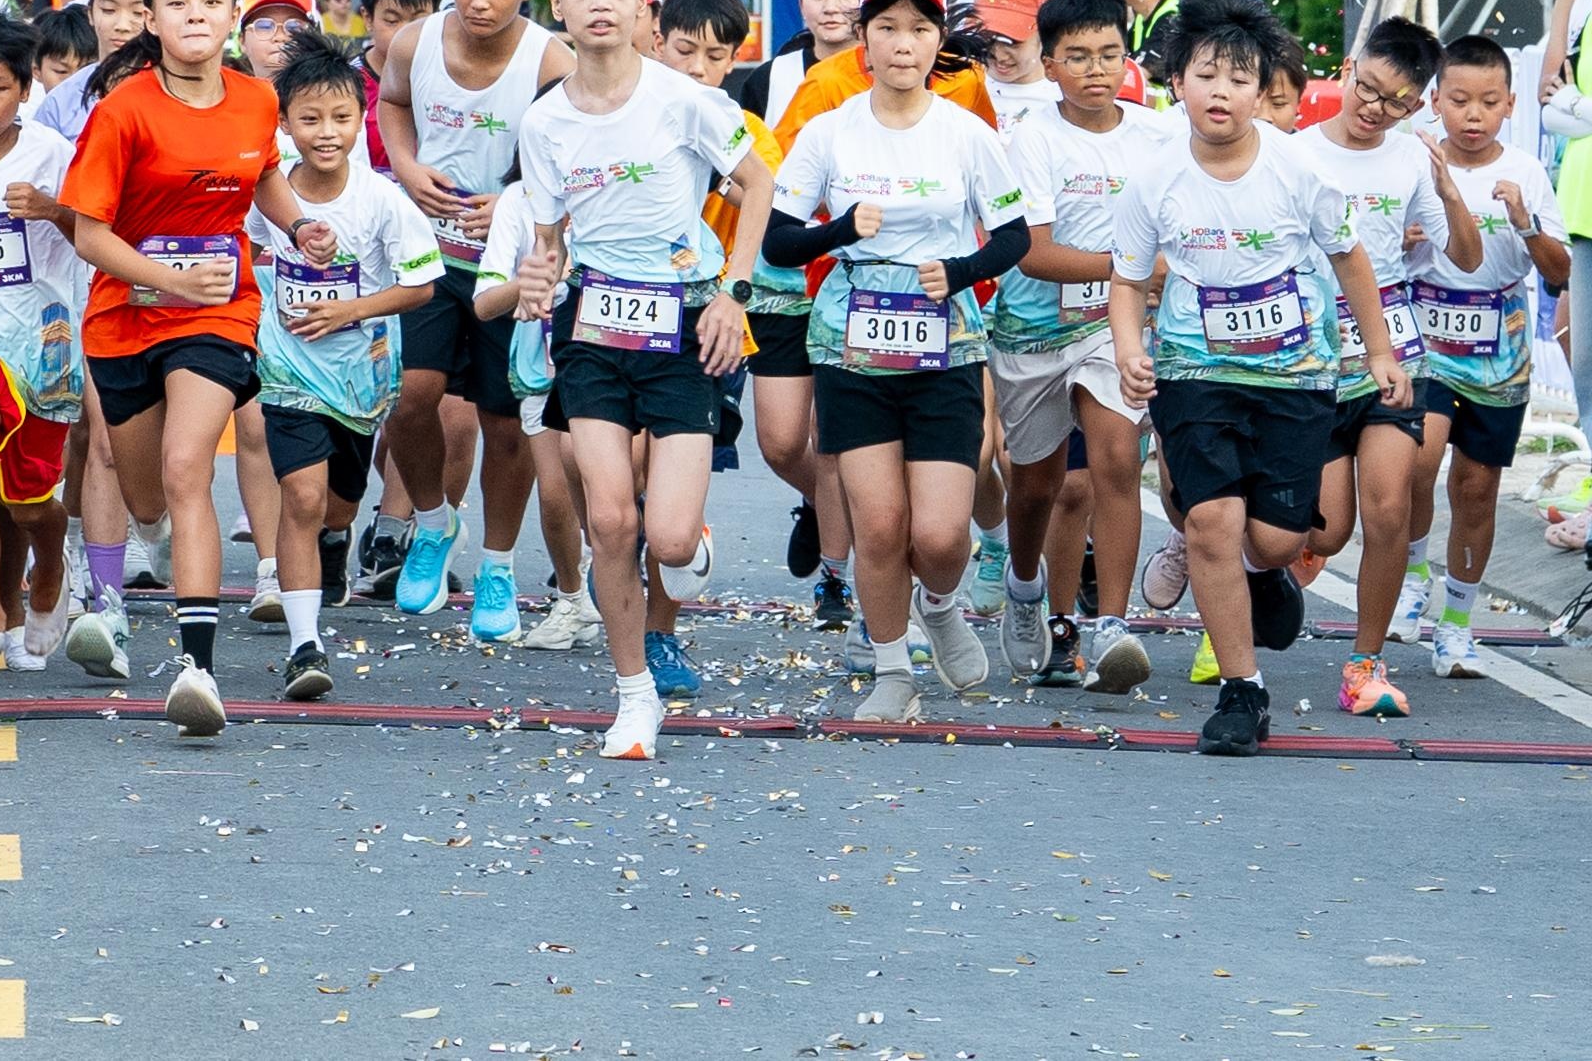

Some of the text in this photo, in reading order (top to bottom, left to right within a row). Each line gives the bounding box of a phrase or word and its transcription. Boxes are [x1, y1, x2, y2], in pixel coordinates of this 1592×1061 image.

[1191, 228, 1225, 236] HDBank
[2, 273, 24, 282] 3KM
[1082, 281, 1104, 299] 31
[600, 294, 658, 322] 3124
[1225, 304, 1283, 331] 3116
[1428, 308, 1482, 333] 3130
[867, 318, 928, 343] 3016
[649, 339, 672, 349] 3KM
[1283, 333, 1302, 346] 3KM
[1473, 346, 1493, 354] 3KM
[919, 358, 941, 367] 3KM
